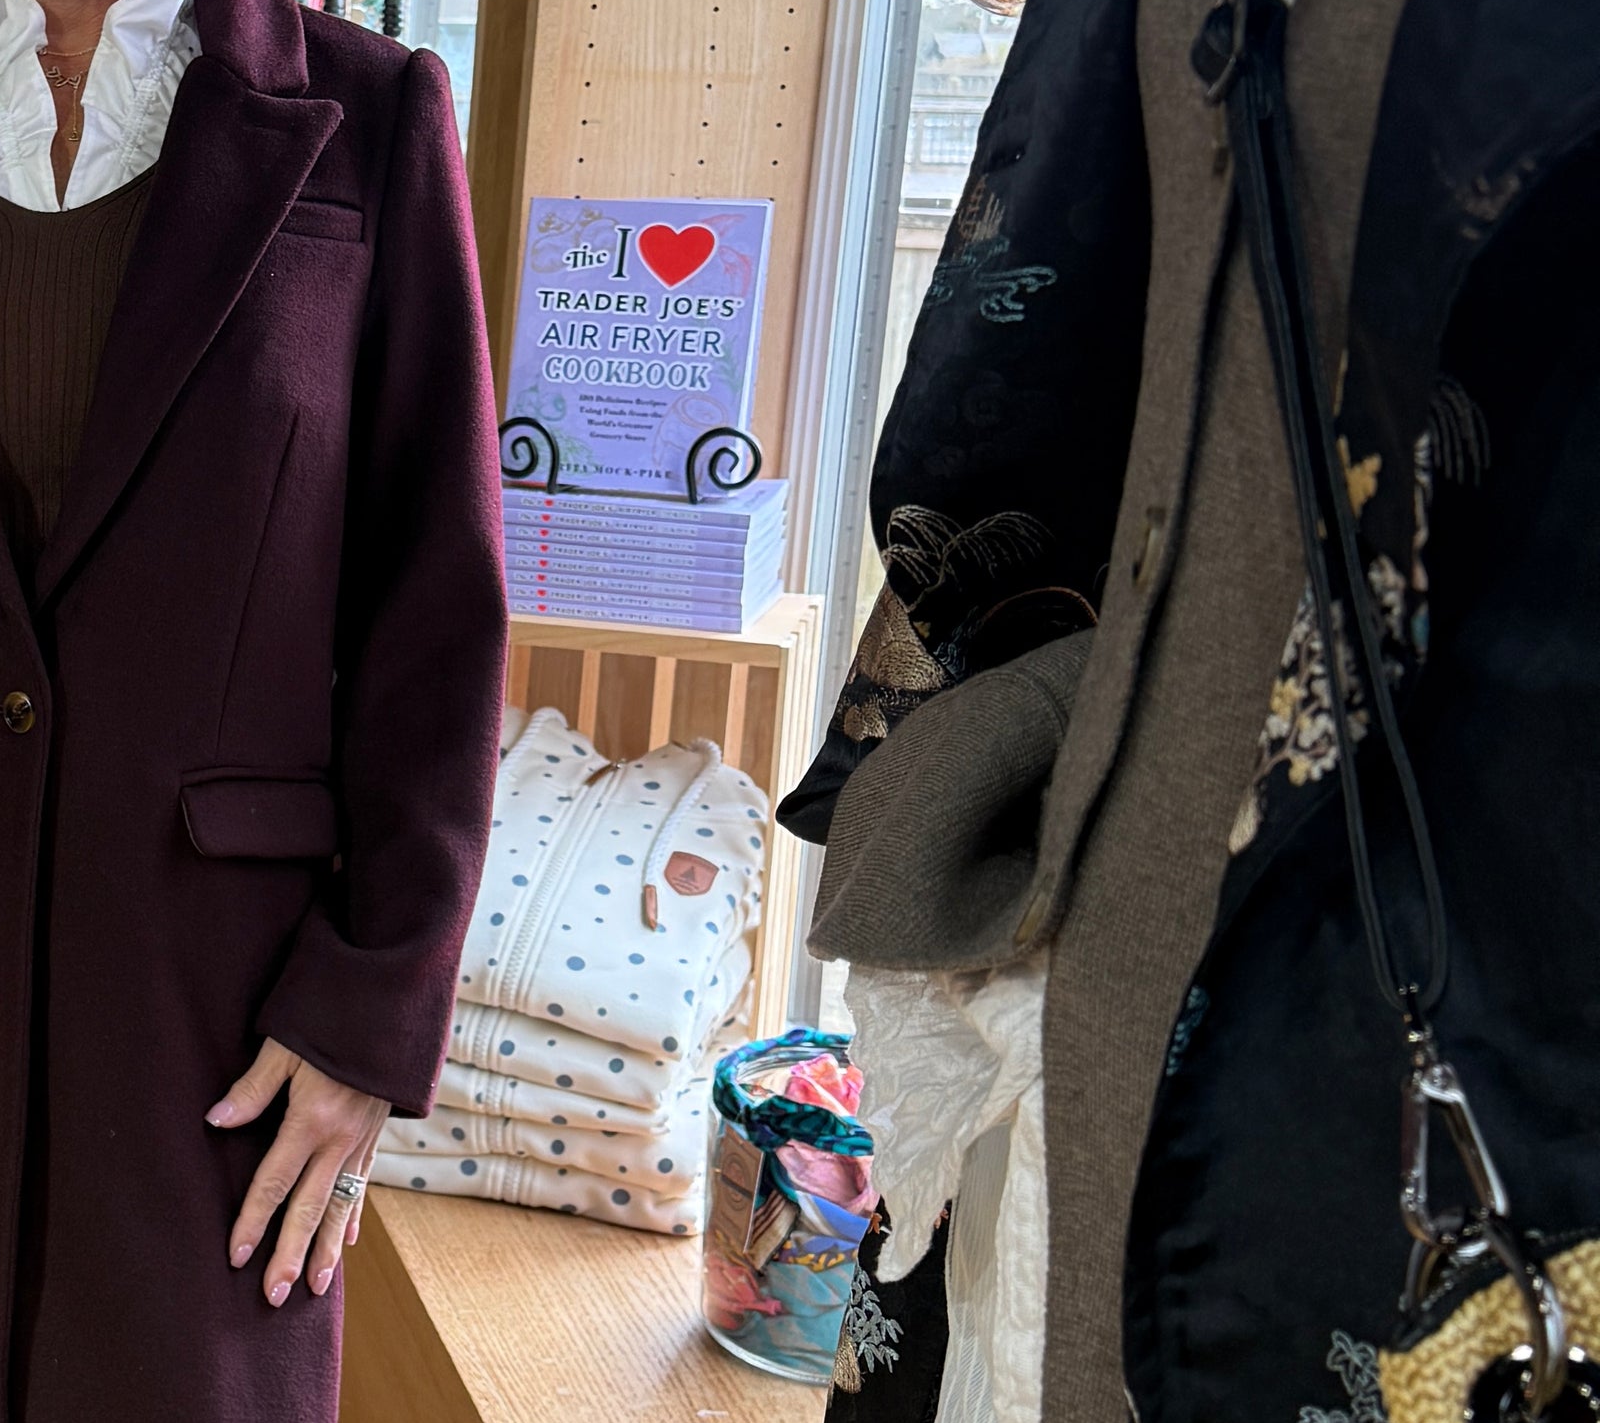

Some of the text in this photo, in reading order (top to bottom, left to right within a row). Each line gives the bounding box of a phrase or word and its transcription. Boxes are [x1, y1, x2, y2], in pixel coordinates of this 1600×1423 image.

[565, 227, 632, 279] The I
[538, 289, 738, 320] TRADER JOE'S
[541, 322, 721, 355] AIR FRYER
[544, 356, 709, 390] COOKBOOK
